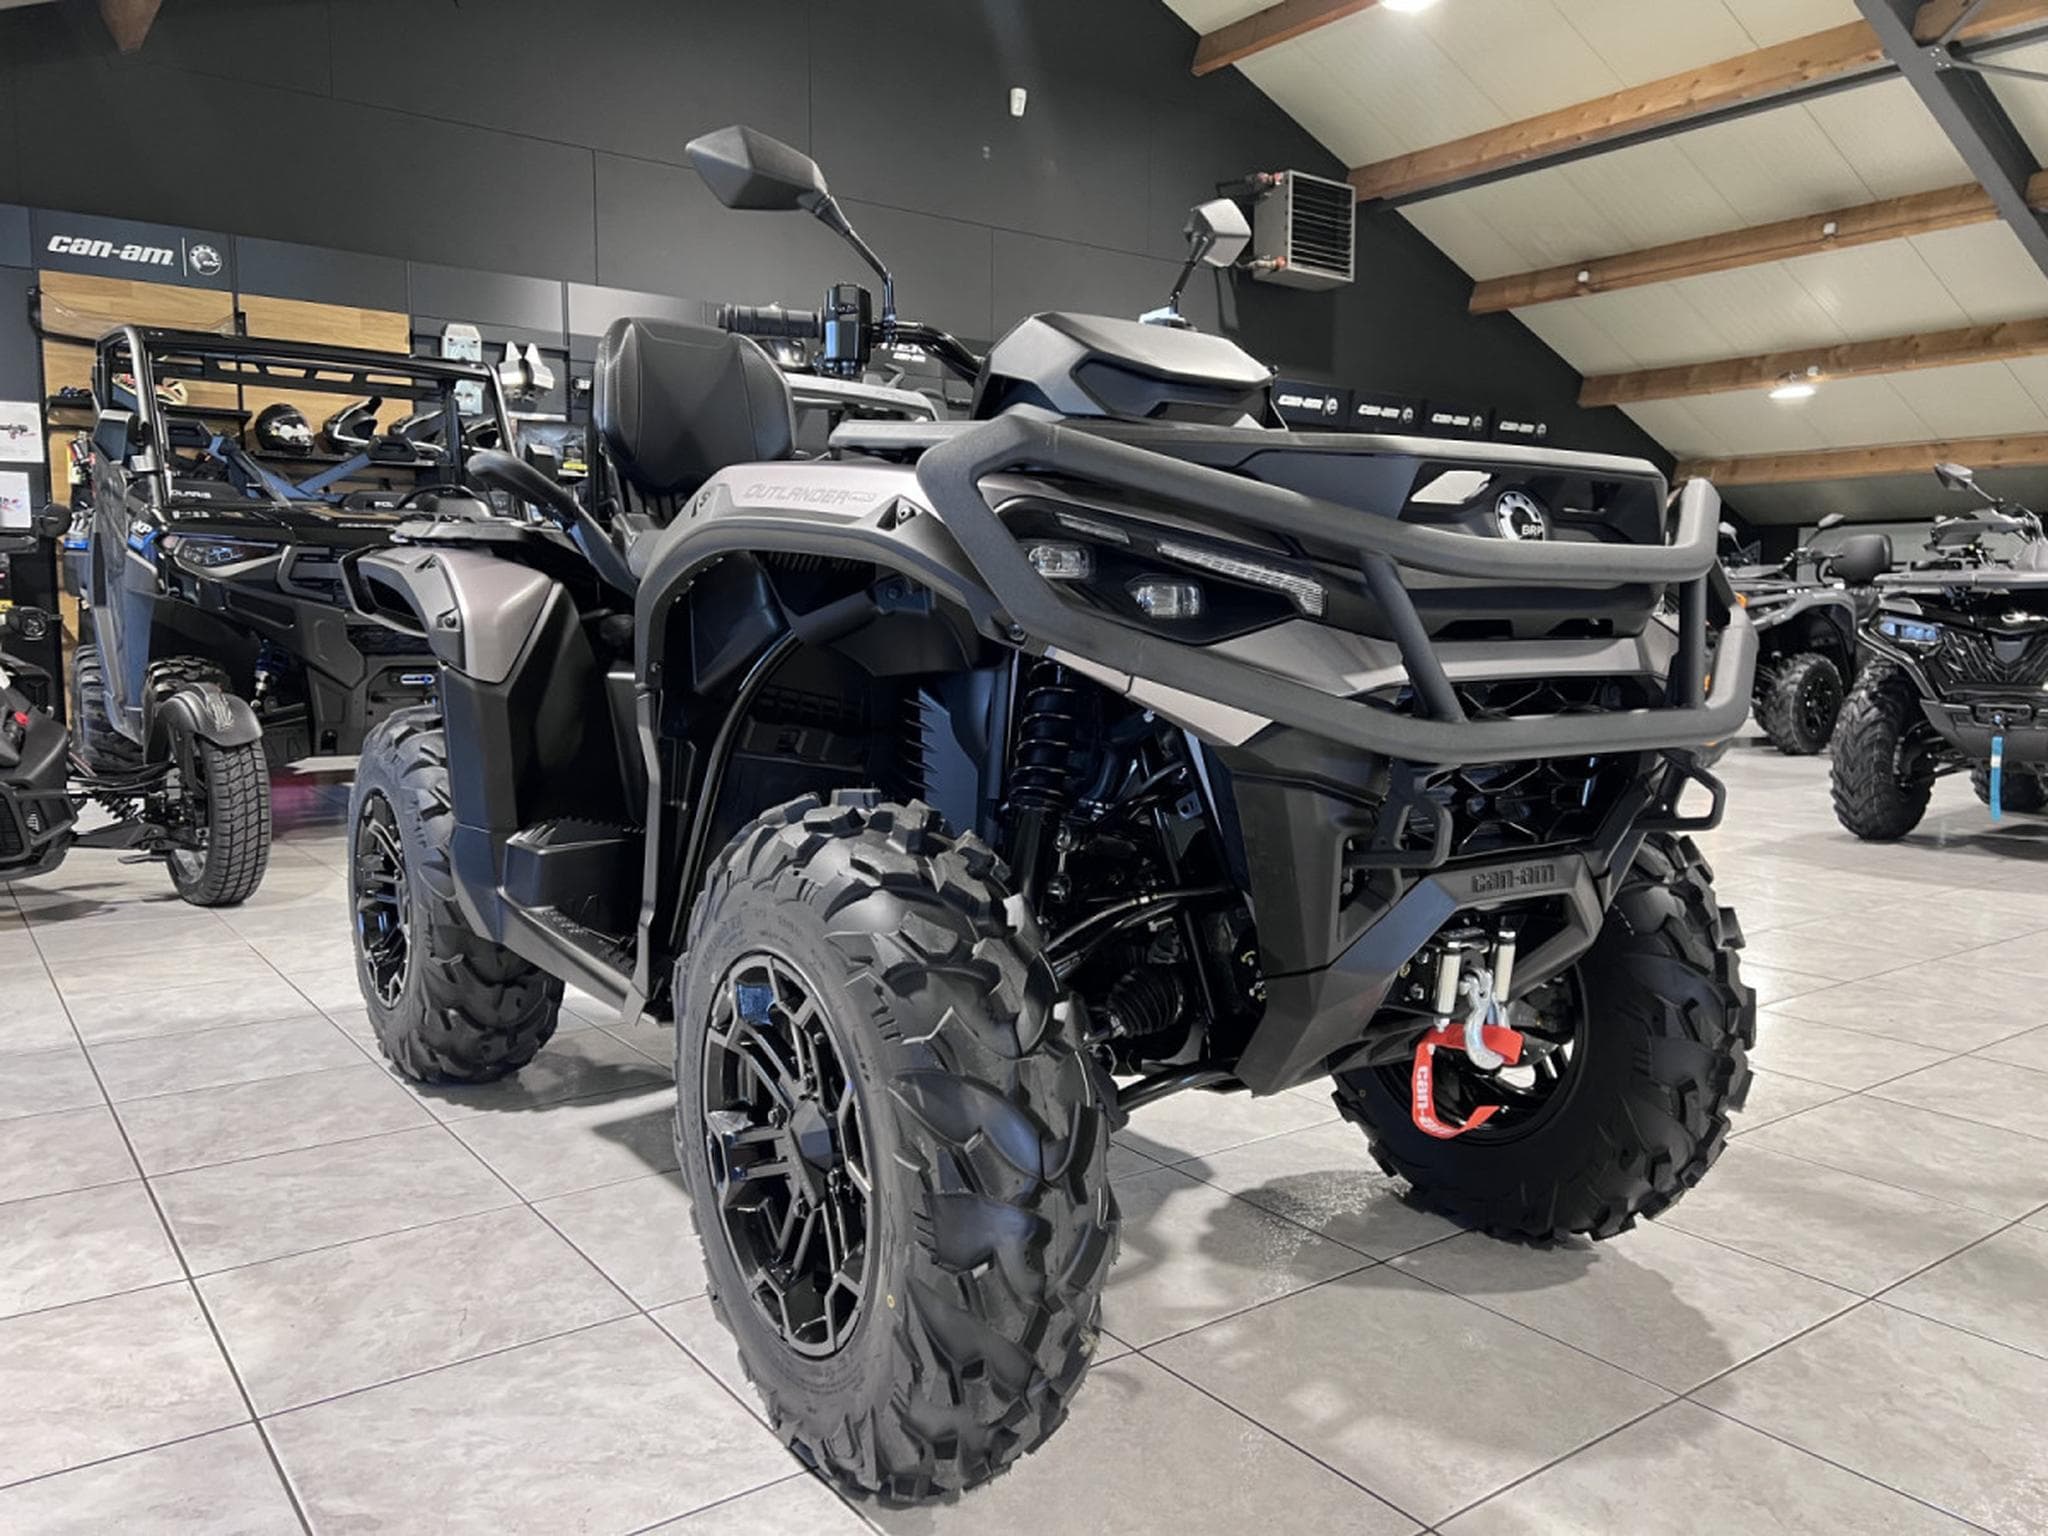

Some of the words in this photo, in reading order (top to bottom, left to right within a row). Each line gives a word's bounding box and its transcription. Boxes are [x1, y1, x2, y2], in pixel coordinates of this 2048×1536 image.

[47, 234, 174, 266] can-am
[744, 482, 850, 505] OUTLANDER
[1471, 863, 1555, 893] can-am
